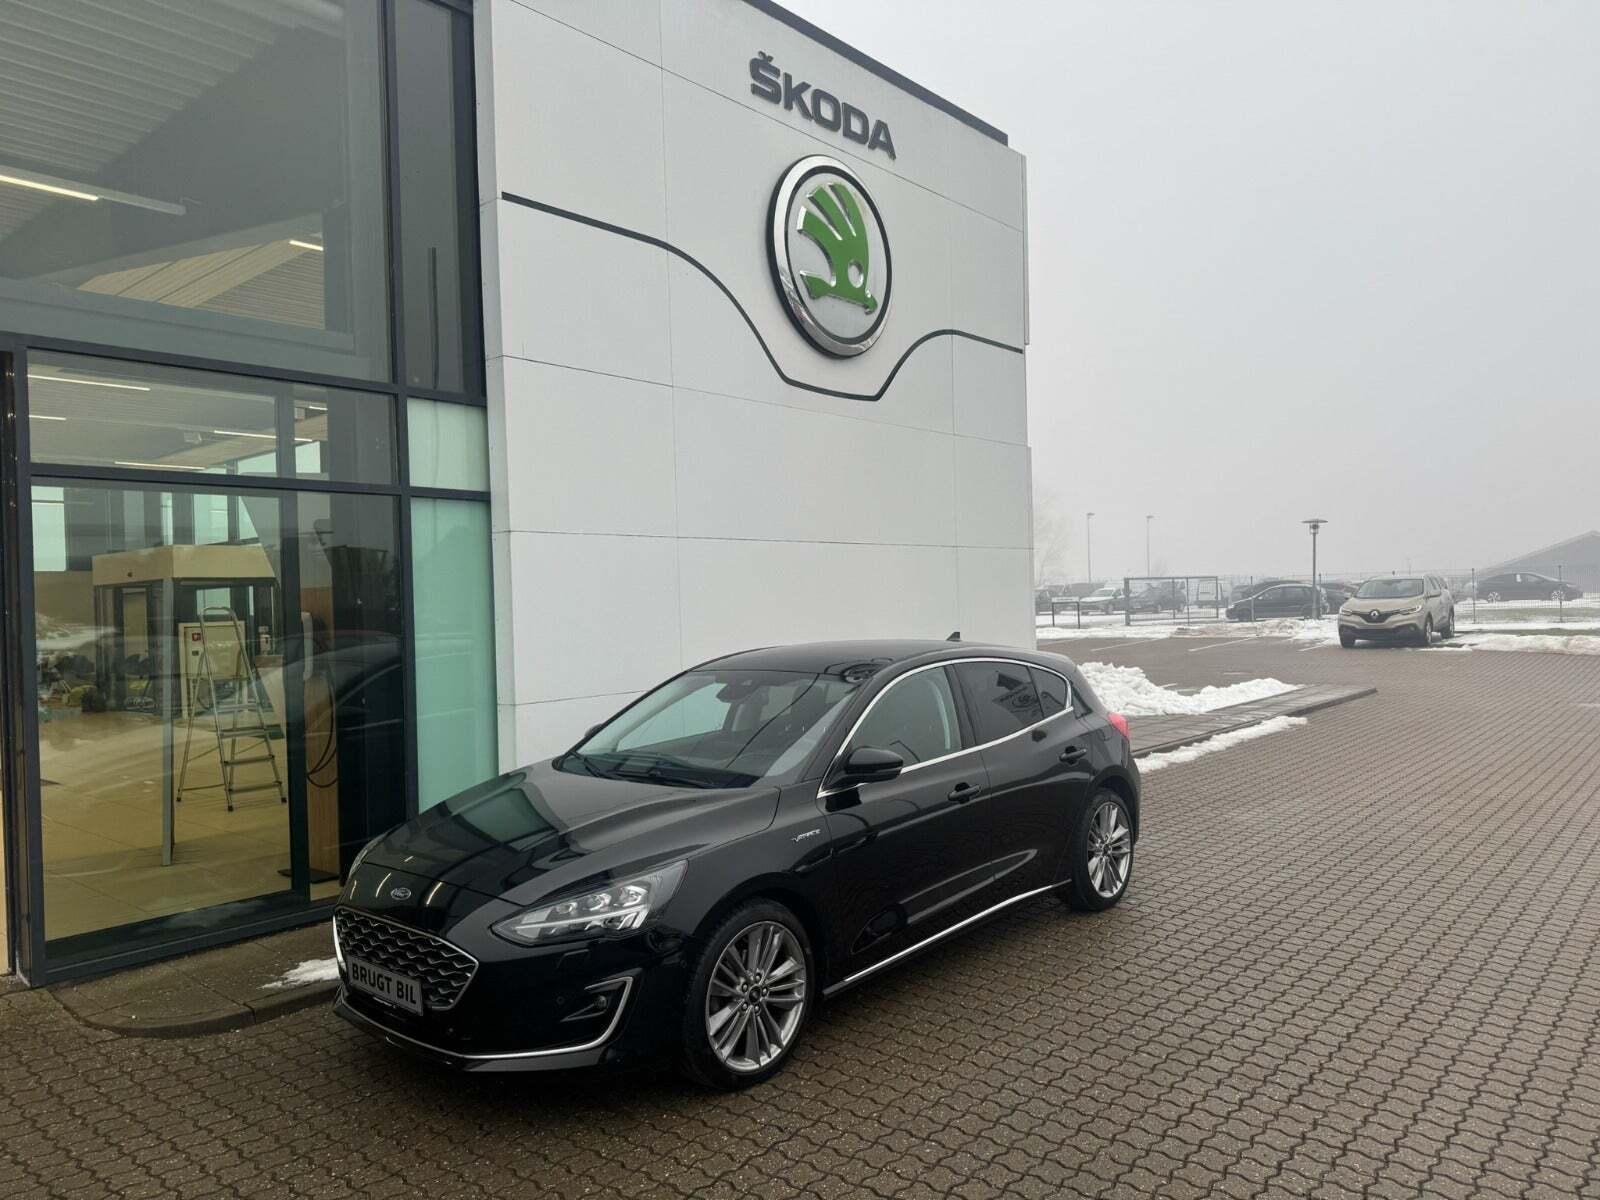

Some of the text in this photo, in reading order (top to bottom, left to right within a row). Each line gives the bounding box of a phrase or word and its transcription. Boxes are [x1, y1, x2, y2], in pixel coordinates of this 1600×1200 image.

[750, 51, 896, 160] ŠKODA
[352, 962, 417, 1005] BRUGT BIL
